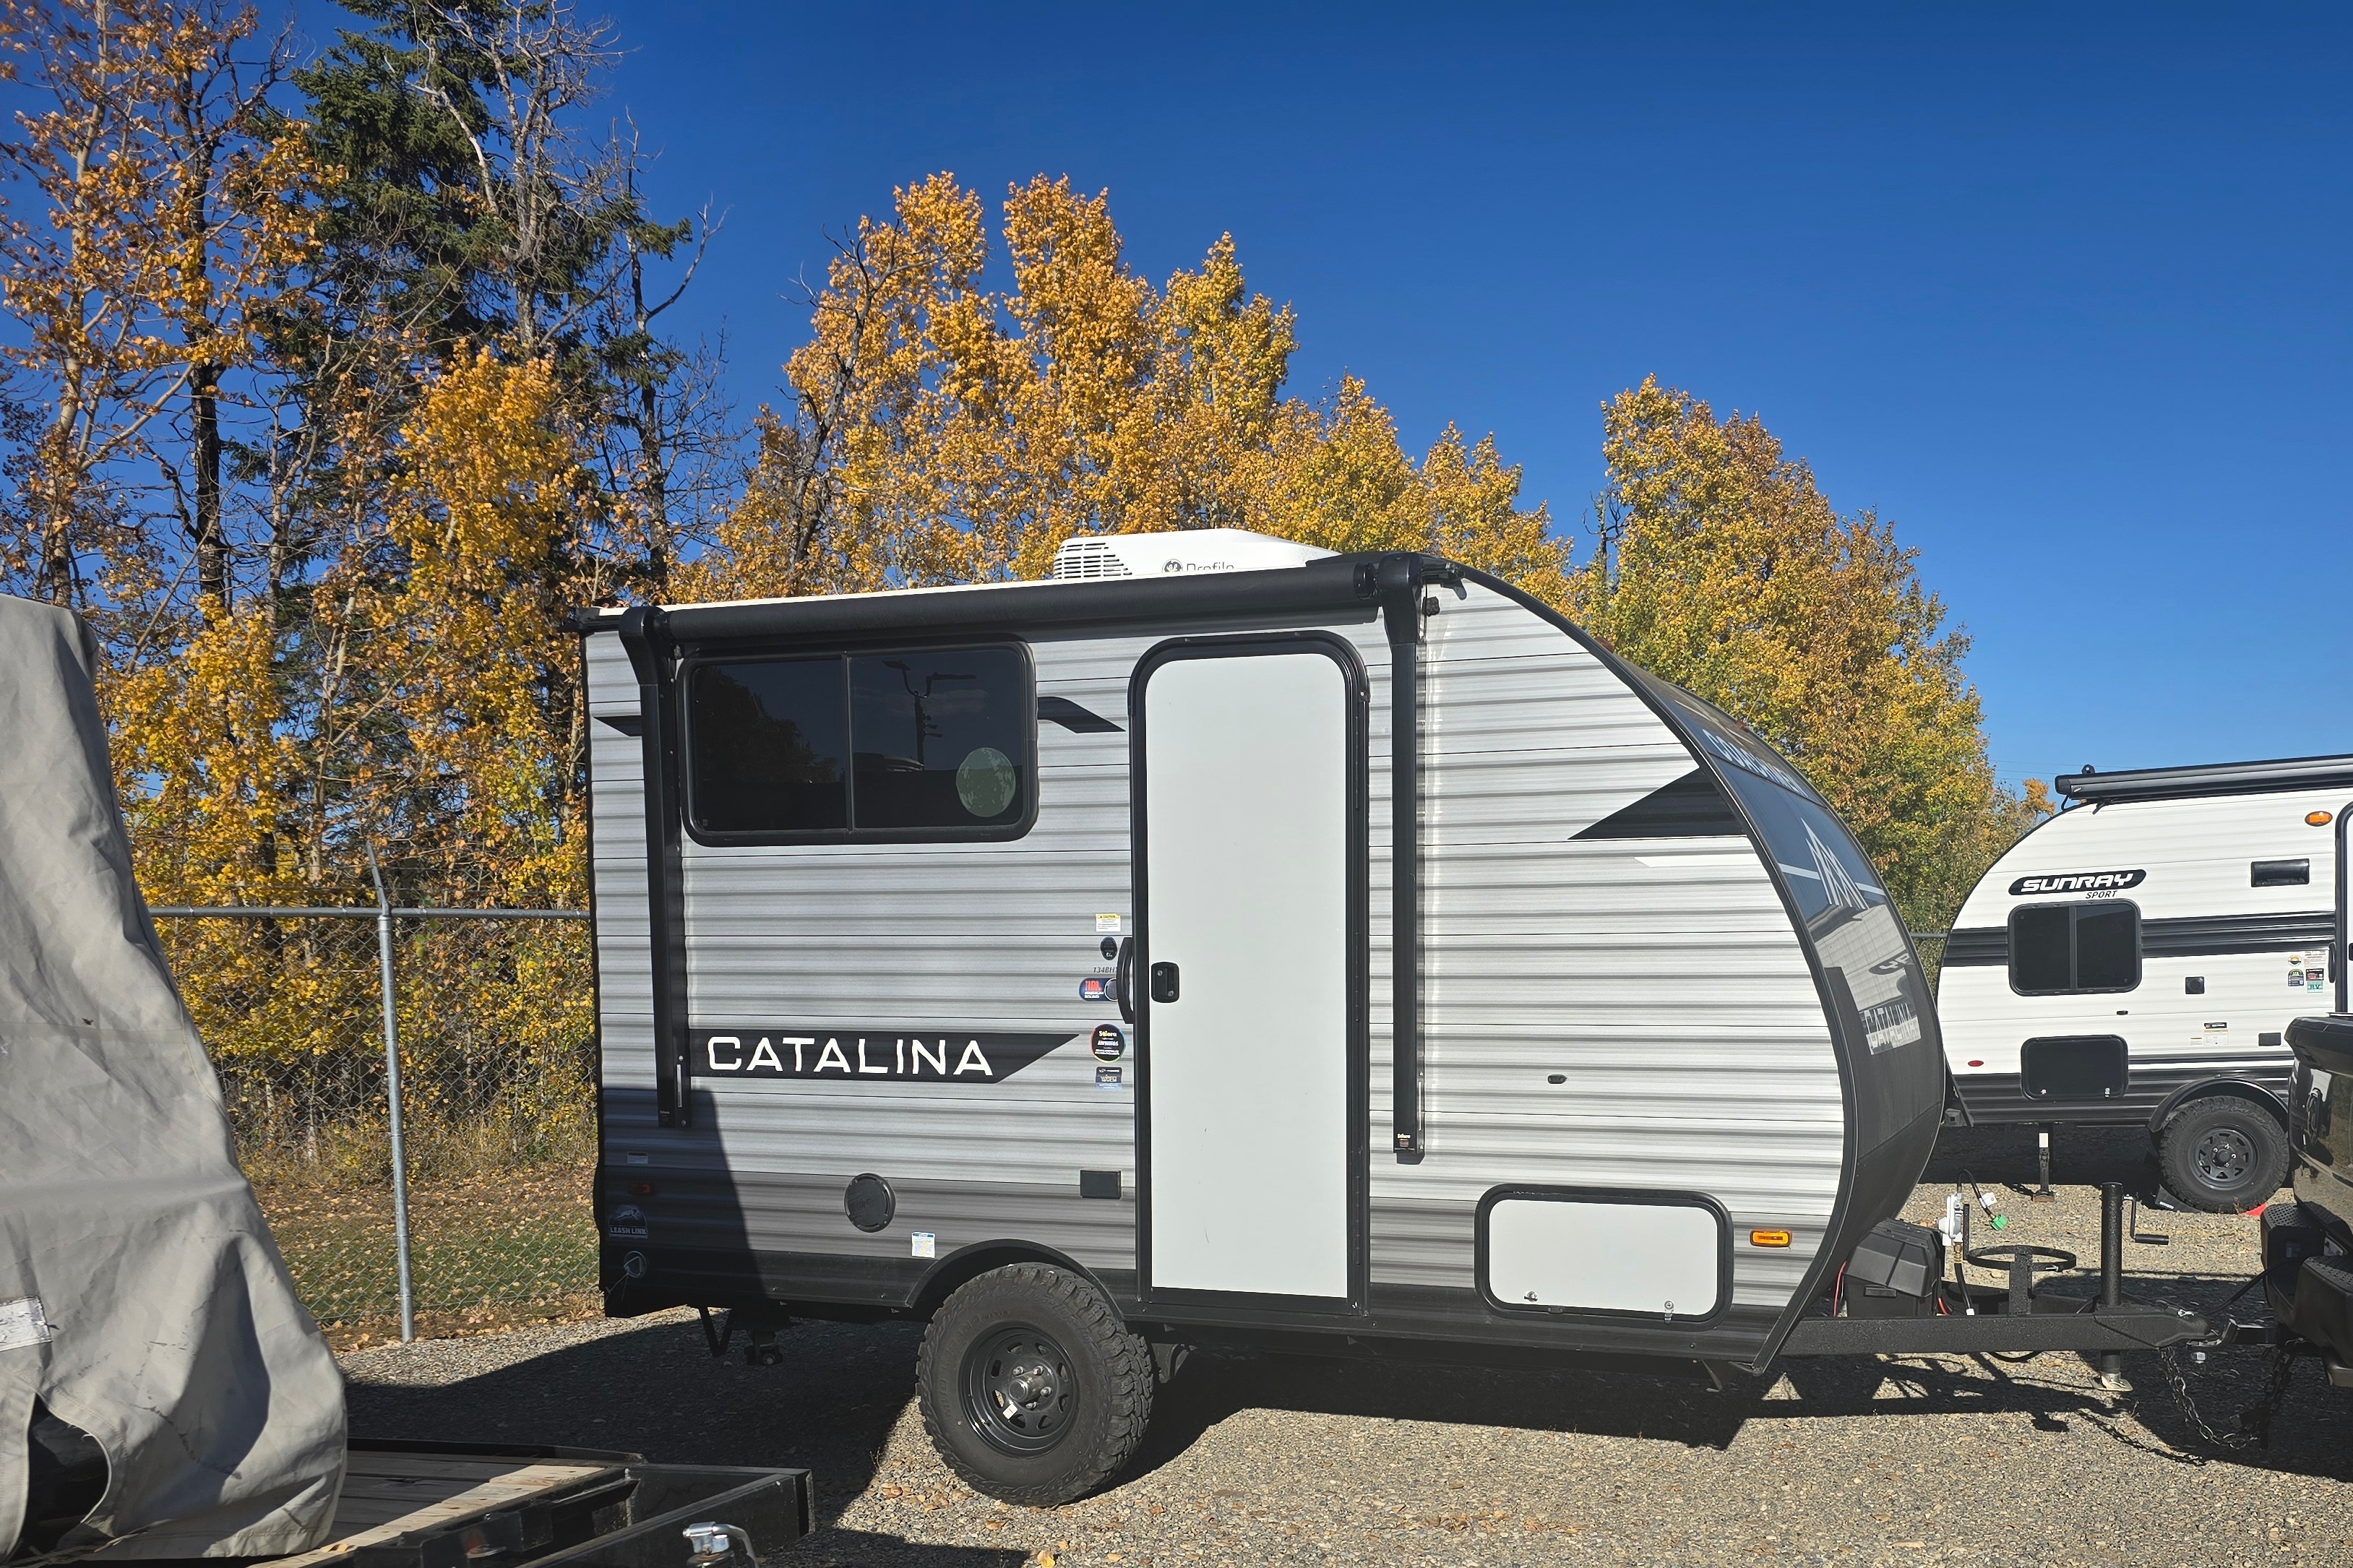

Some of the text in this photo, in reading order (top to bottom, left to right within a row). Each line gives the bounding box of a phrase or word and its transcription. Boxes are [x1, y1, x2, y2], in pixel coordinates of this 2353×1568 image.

[1702, 728, 1808, 798] COACHMEN
[2021, 873, 2134, 892] SUNRAY
[2085, 889, 2118, 899] SPORT
[707, 1036, 993, 1076] CATALINA
